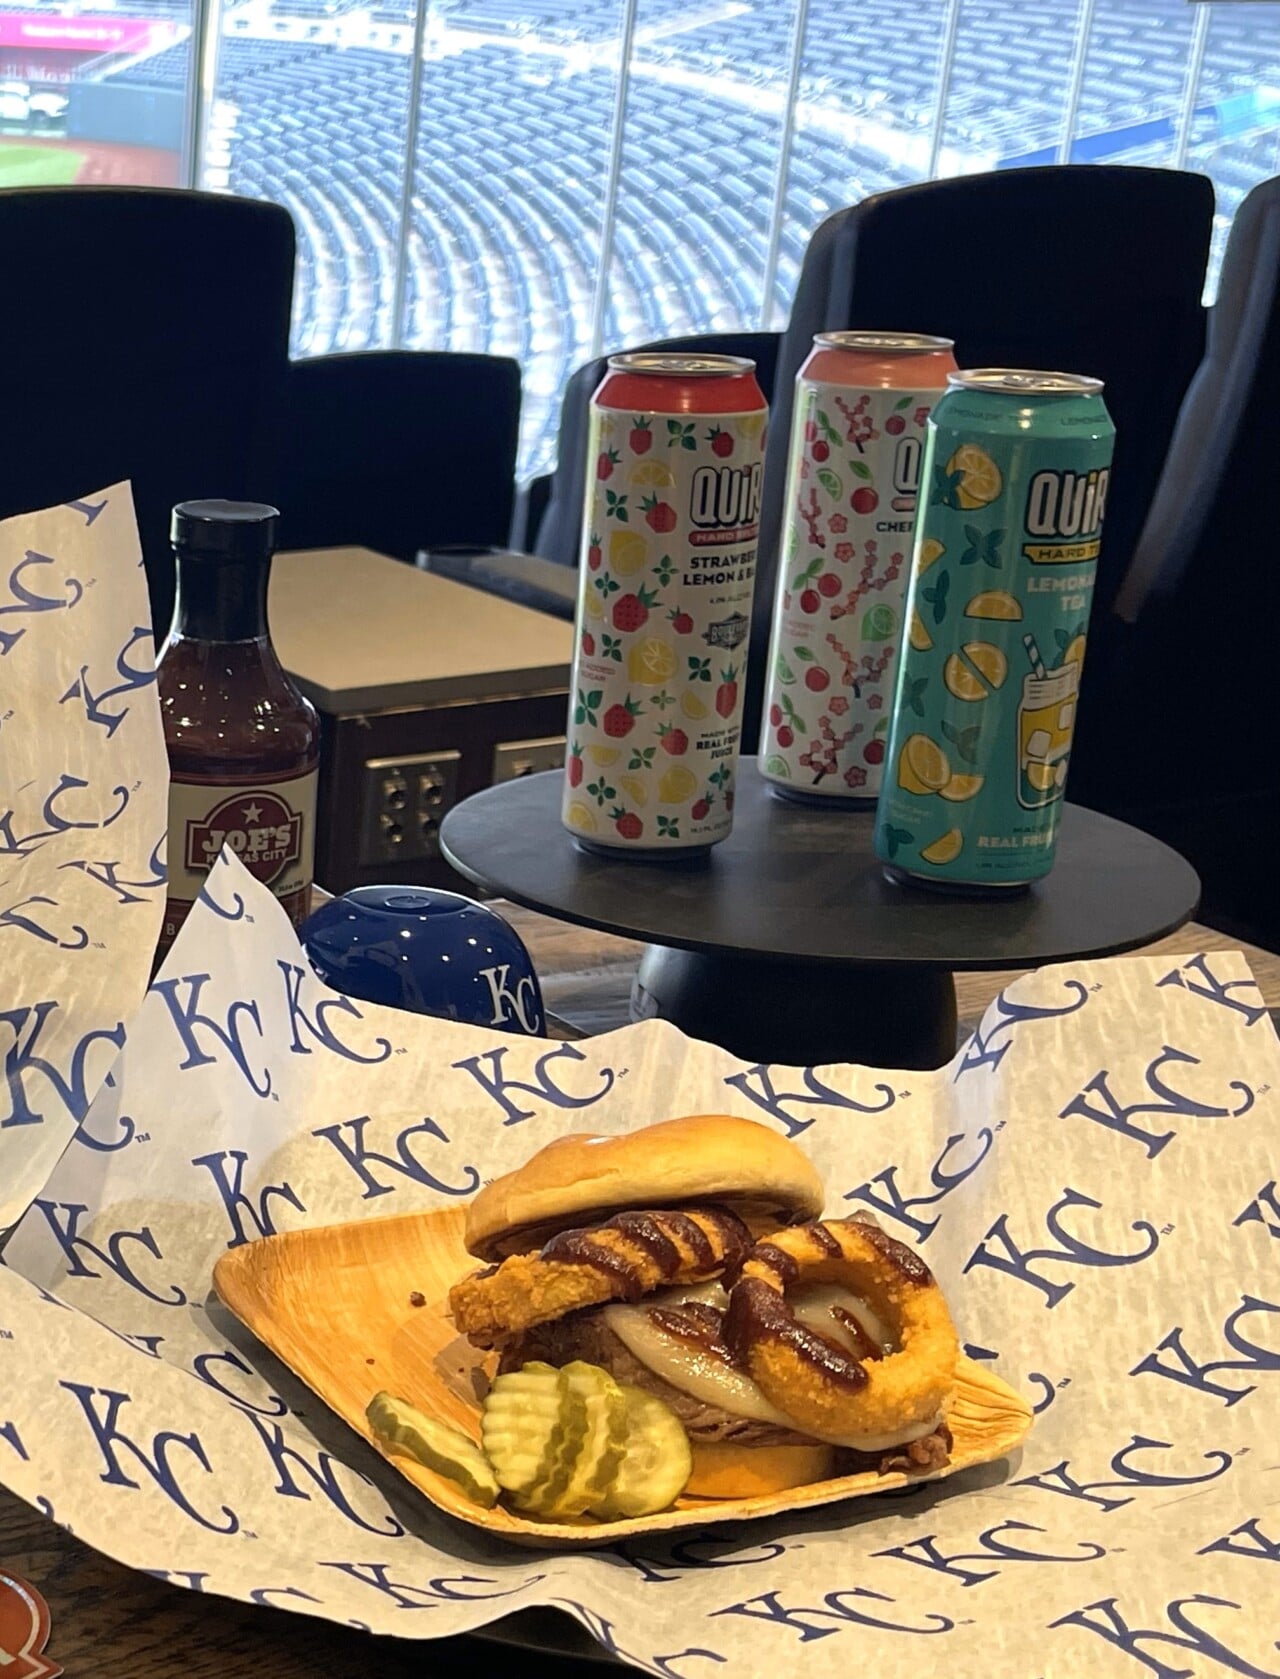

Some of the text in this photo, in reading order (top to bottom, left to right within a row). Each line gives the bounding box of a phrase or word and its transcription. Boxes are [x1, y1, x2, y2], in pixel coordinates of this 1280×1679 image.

[683, 571, 735, 587] LEMON
[1038, 547, 1086, 559] HARD
[696, 740, 722, 751] REAL
[201, 822, 292, 854] JOE'S
[261, 848, 288, 862] CITY
[977, 835, 1019, 849] REAL
[150, 974, 271, 1099] KC
[278, 959, 390, 1064] KC
[478, 964, 540, 1035] KC
[954, 979, 1089, 1084] KC
[451, 1043, 615, 1128] KC
[1058, 1045, 1256, 1161] KC
[313, 1116, 480, 1200] KC
[843, 1127, 994, 1245] KC
[32, 1198, 187, 1308] KC
[963, 1187, 1160, 1310] KC
[59, 1379, 240, 1536] KC
[230, 1401, 405, 1538] KC
[1007, 1434, 1233, 1513] KC
[868, 1519, 1107, 1588] KC
[708, 1587, 956, 1643] KC
